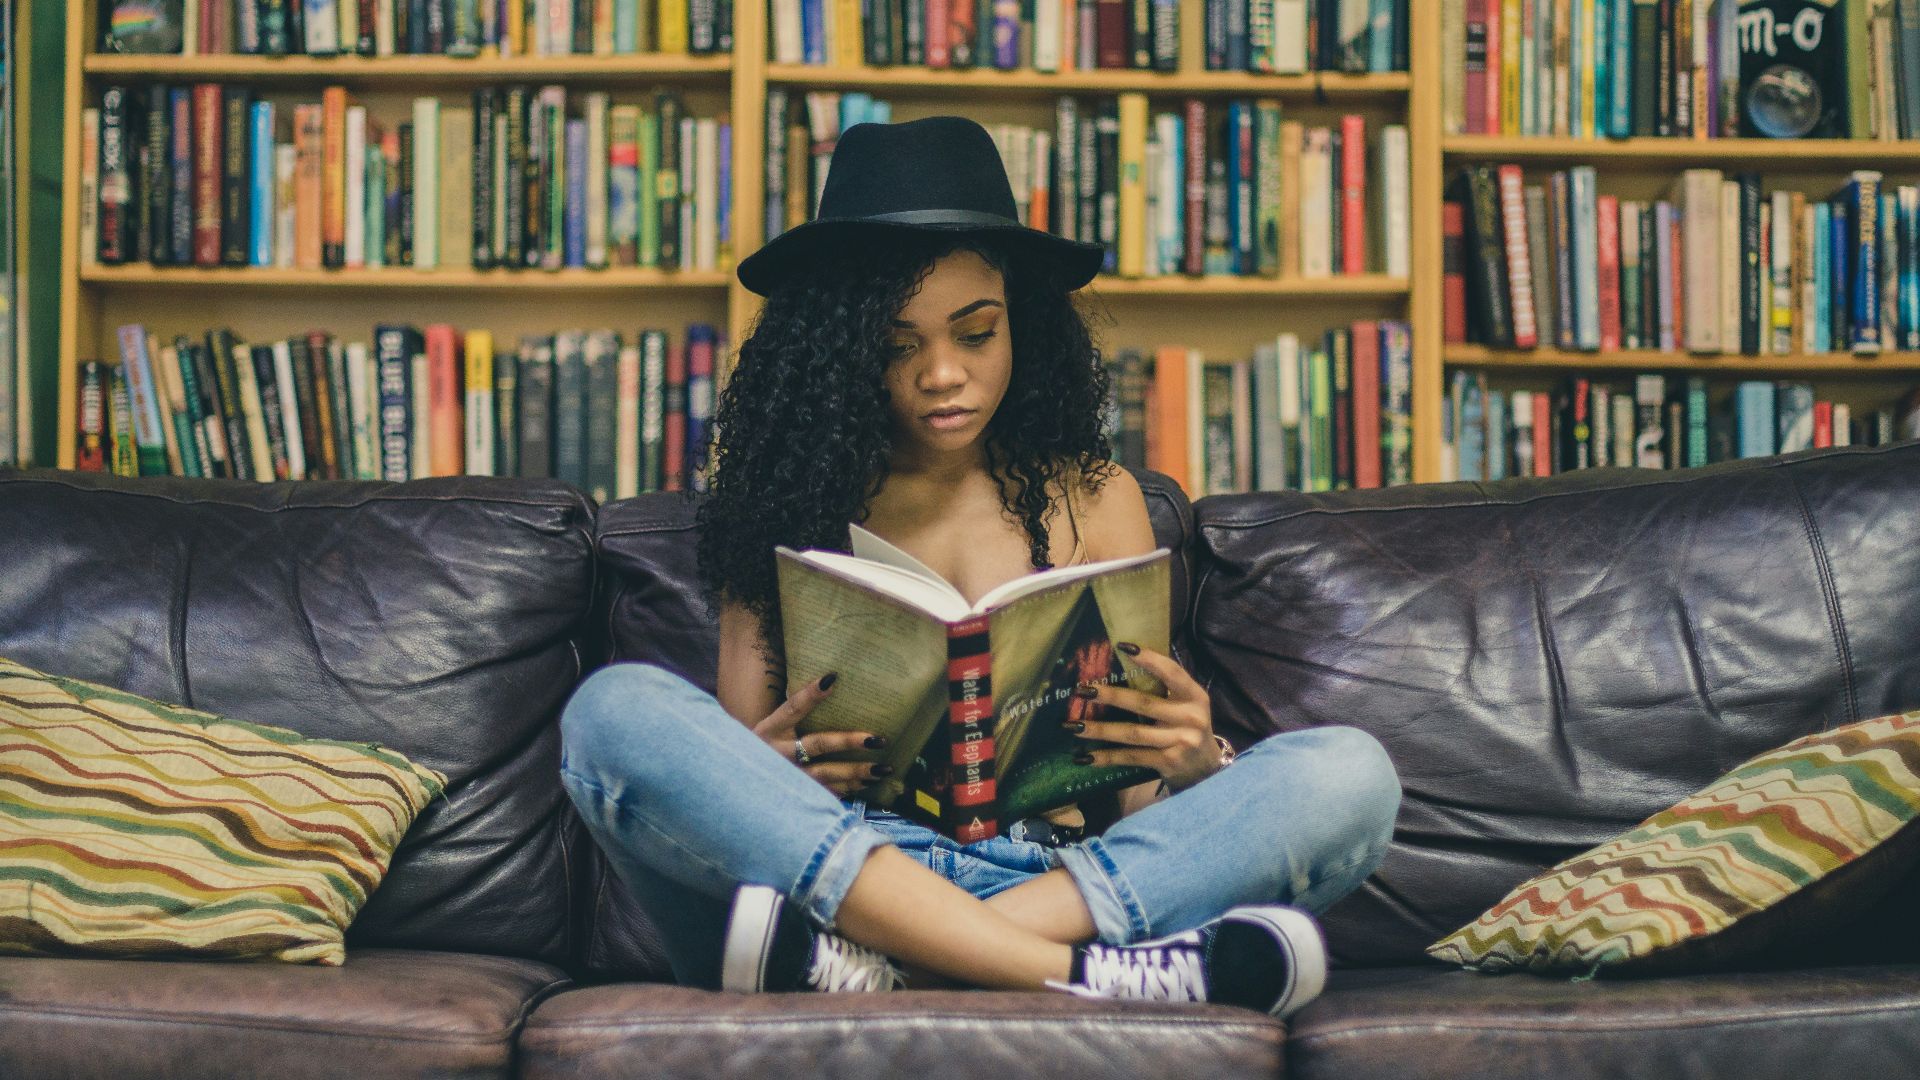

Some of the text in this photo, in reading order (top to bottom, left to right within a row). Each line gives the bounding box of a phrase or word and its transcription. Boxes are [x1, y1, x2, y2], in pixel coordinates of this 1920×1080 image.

[379, 331, 404, 396] BLUE
[1009, 694, 1050, 719] Water
[1055, 686, 1072, 701] for
[962, 667, 984, 796] Water for Elephants
[1066, 776, 1100, 793] SARA
